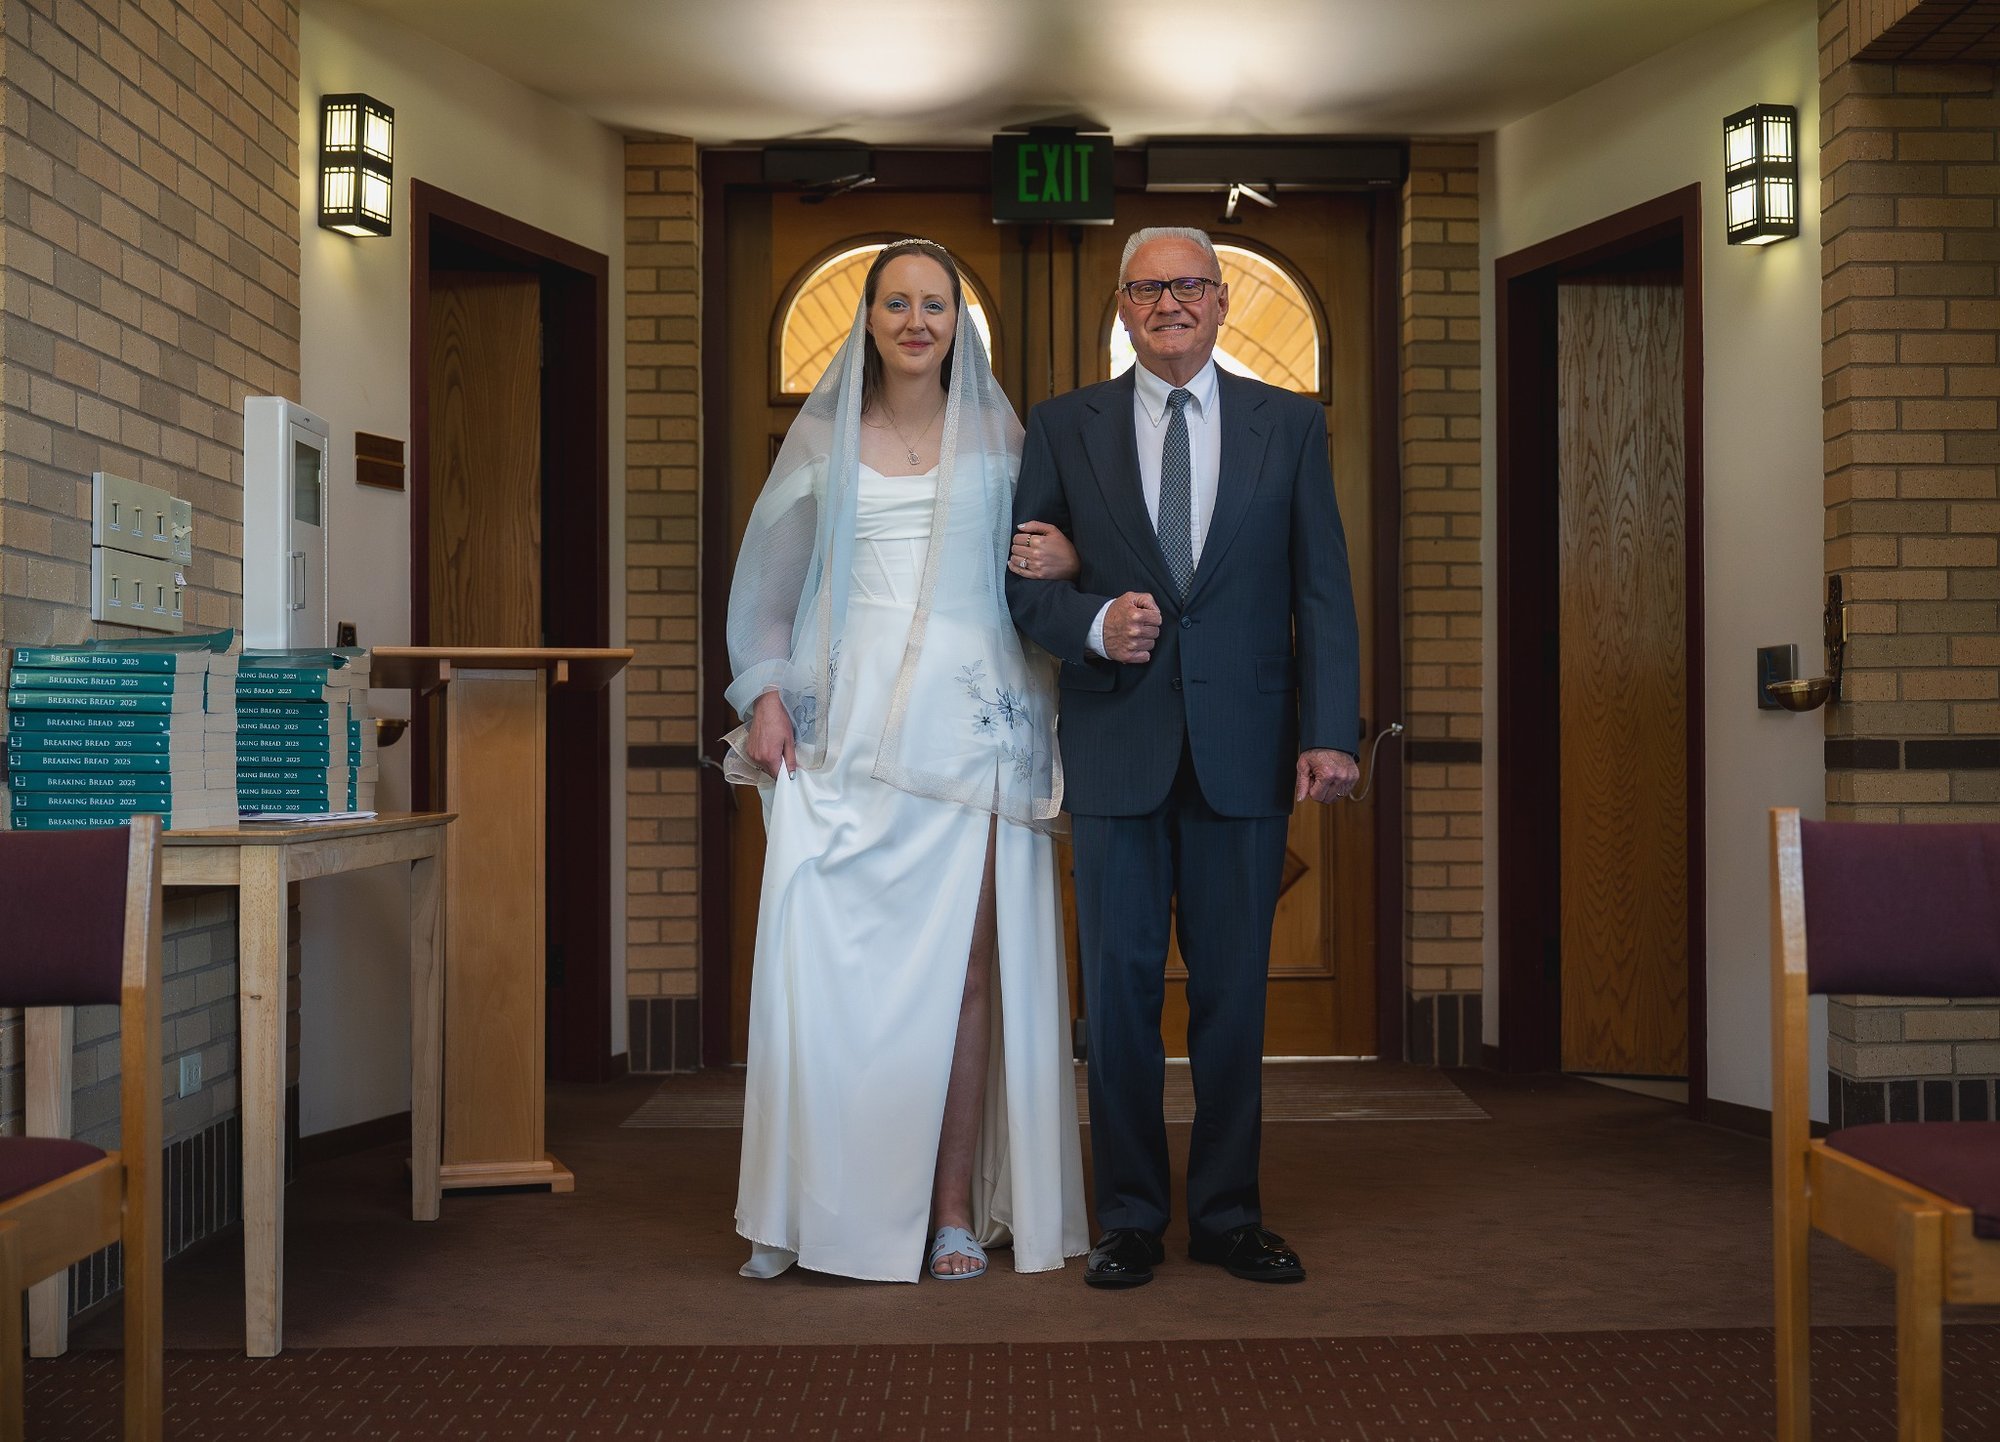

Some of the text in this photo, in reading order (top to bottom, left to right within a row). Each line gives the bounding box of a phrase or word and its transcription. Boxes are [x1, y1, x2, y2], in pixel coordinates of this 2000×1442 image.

[1018, 144, 1094, 202] EXIT
[50, 654, 90, 664] BREAKING
[48, 676, 88, 684] BREAKING
[48, 696, 87, 704] BREAKING
[90, 698, 115, 706] BREAD
[43, 738, 82, 746] BREAKING
[48, 778, 86, 786] BREAKING
[48, 797, 87, 805] BREAKING
[90, 798, 115, 806] BREAD
